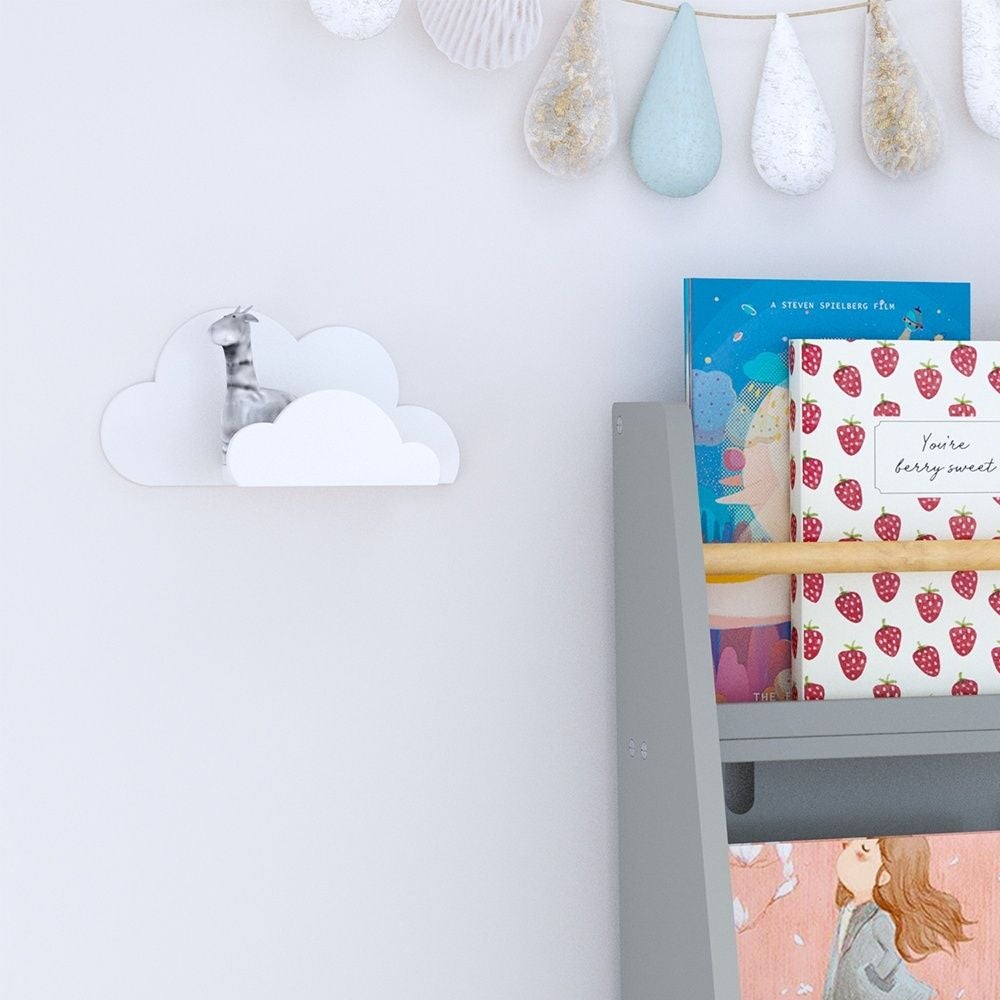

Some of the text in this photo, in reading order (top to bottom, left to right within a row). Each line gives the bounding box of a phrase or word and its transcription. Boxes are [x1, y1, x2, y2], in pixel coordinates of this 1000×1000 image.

[770, 301, 896, 310] A STEVEN SPIELBERG FILM
[921, 432, 971, 452] You're
[894, 458, 998, 482] berry sweet
[753, 691, 776, 702] THE
